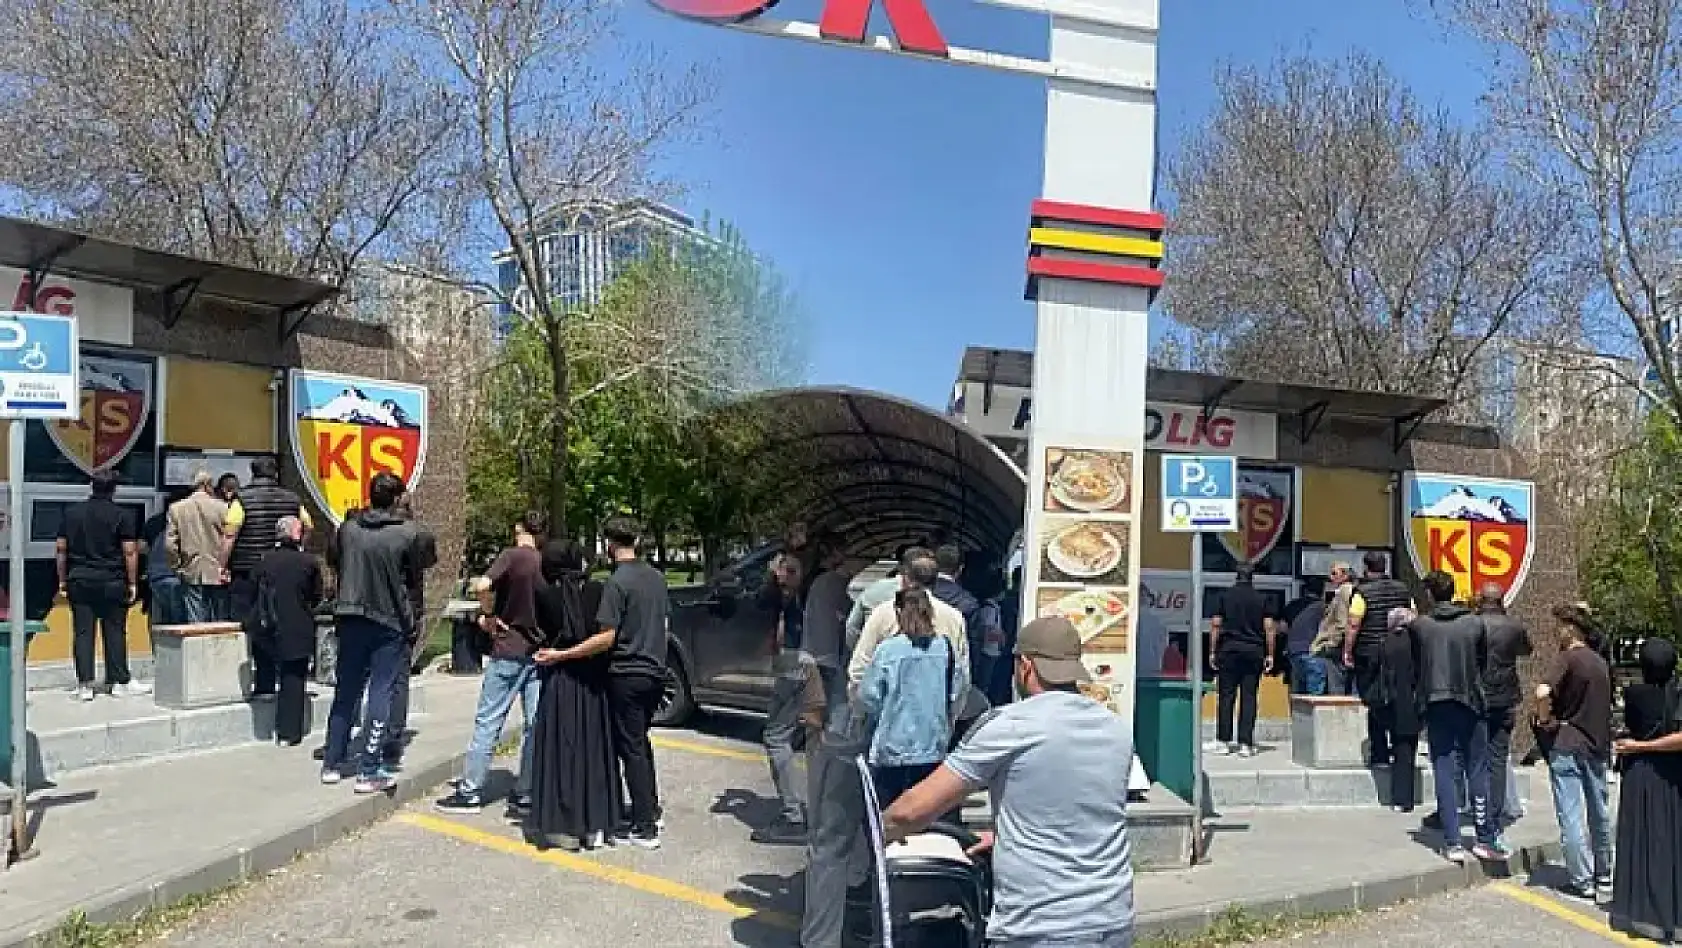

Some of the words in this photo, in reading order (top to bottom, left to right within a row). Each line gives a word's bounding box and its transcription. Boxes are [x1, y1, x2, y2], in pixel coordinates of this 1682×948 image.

[318, 431, 406, 481] KS
[1181, 462, 1206, 493] P
[1429, 527, 1512, 576] KS
